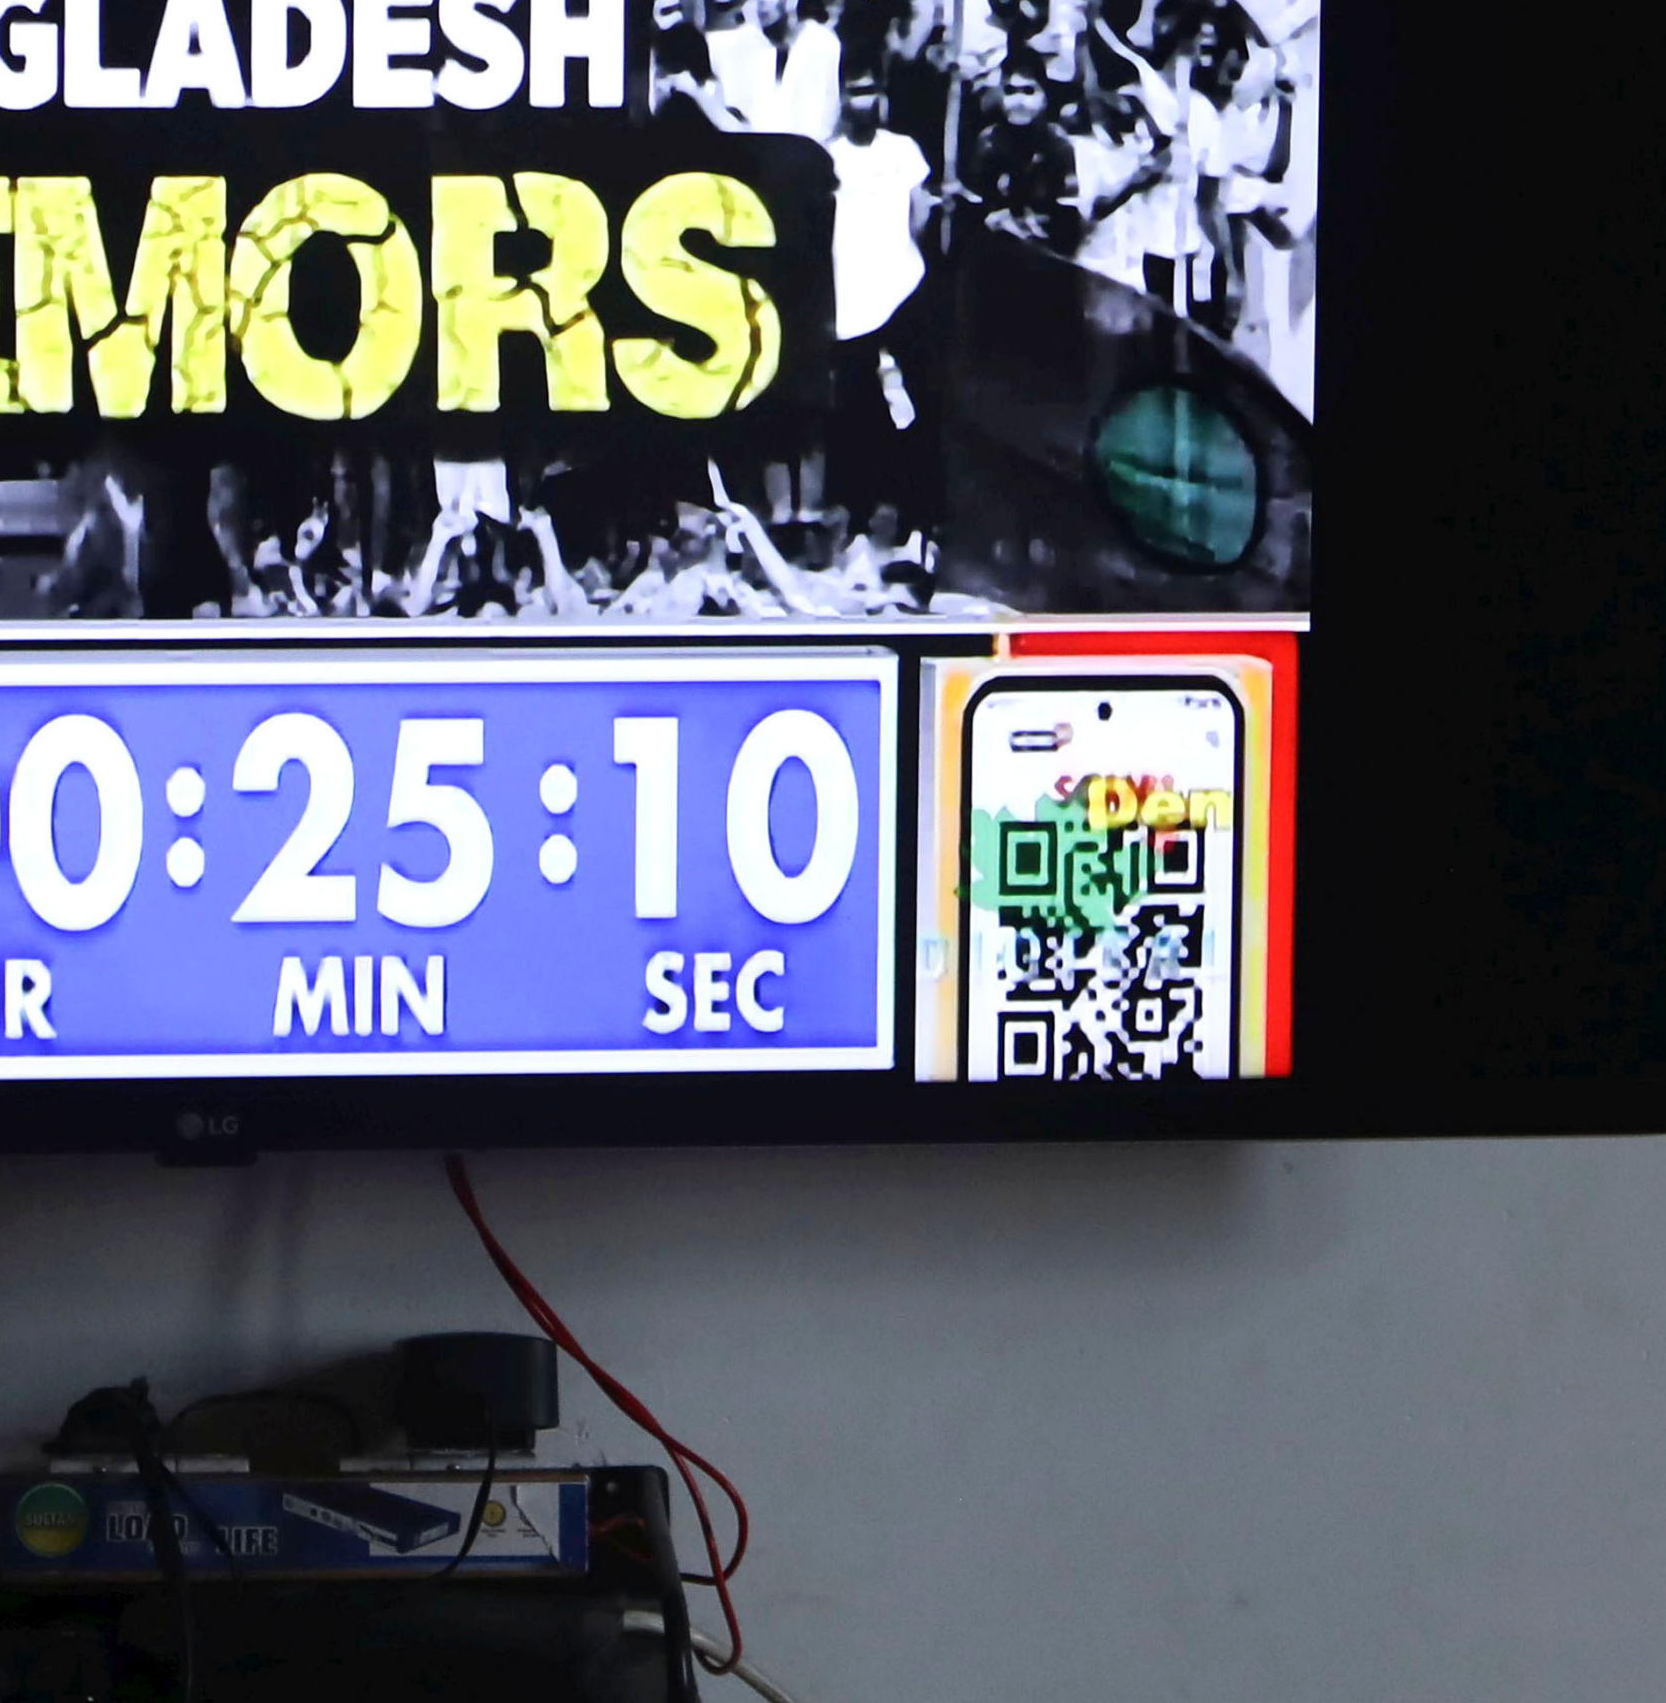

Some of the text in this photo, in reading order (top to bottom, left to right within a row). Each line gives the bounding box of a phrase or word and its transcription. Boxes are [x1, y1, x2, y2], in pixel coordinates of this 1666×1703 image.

[273, 954, 445, 1037] MIN
[642, 949, 785, 1034] SEC
[208, 1115, 239, 1135] LG
[106, 1512, 189, 1542] LOD
